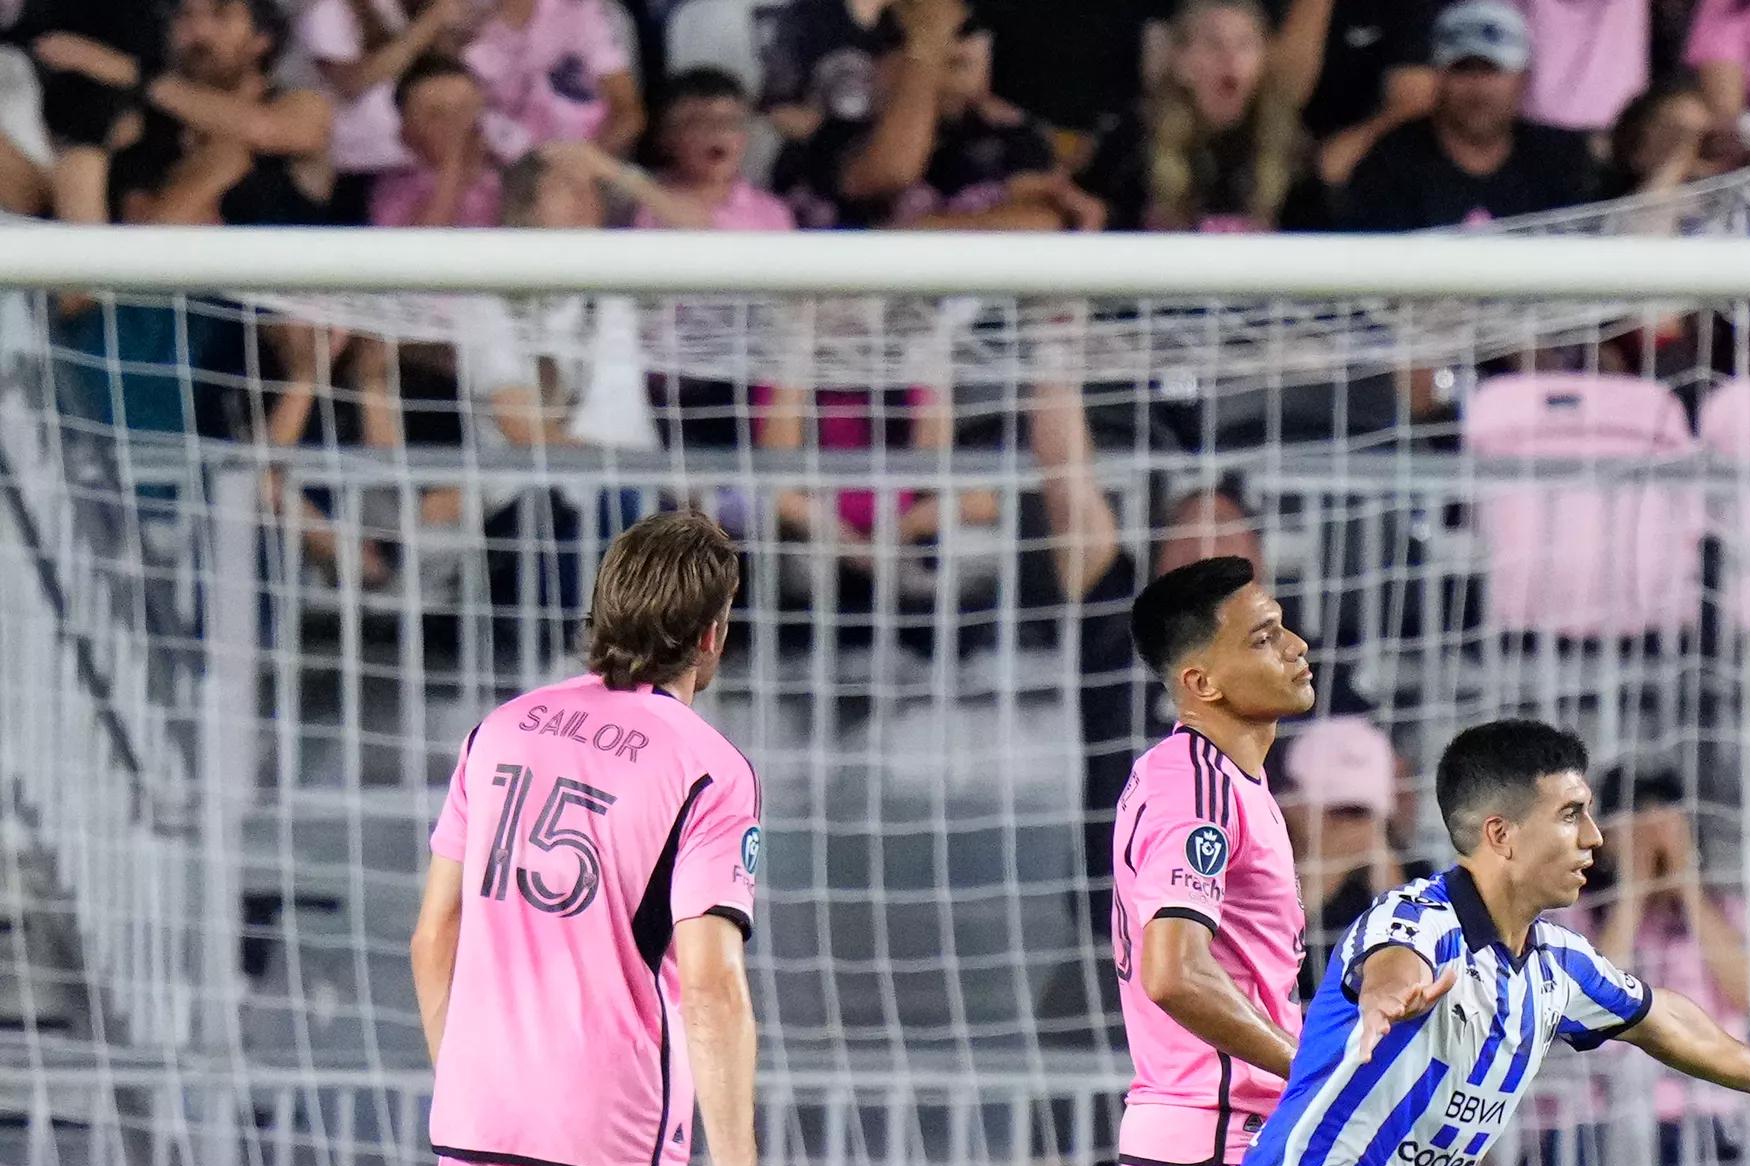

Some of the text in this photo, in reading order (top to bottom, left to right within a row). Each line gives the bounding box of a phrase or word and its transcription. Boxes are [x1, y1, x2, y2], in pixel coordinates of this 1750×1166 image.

[518, 704, 650, 762] SAILOR
[479, 763, 618, 918] 15
[1445, 1090, 1507, 1124] BBVA
